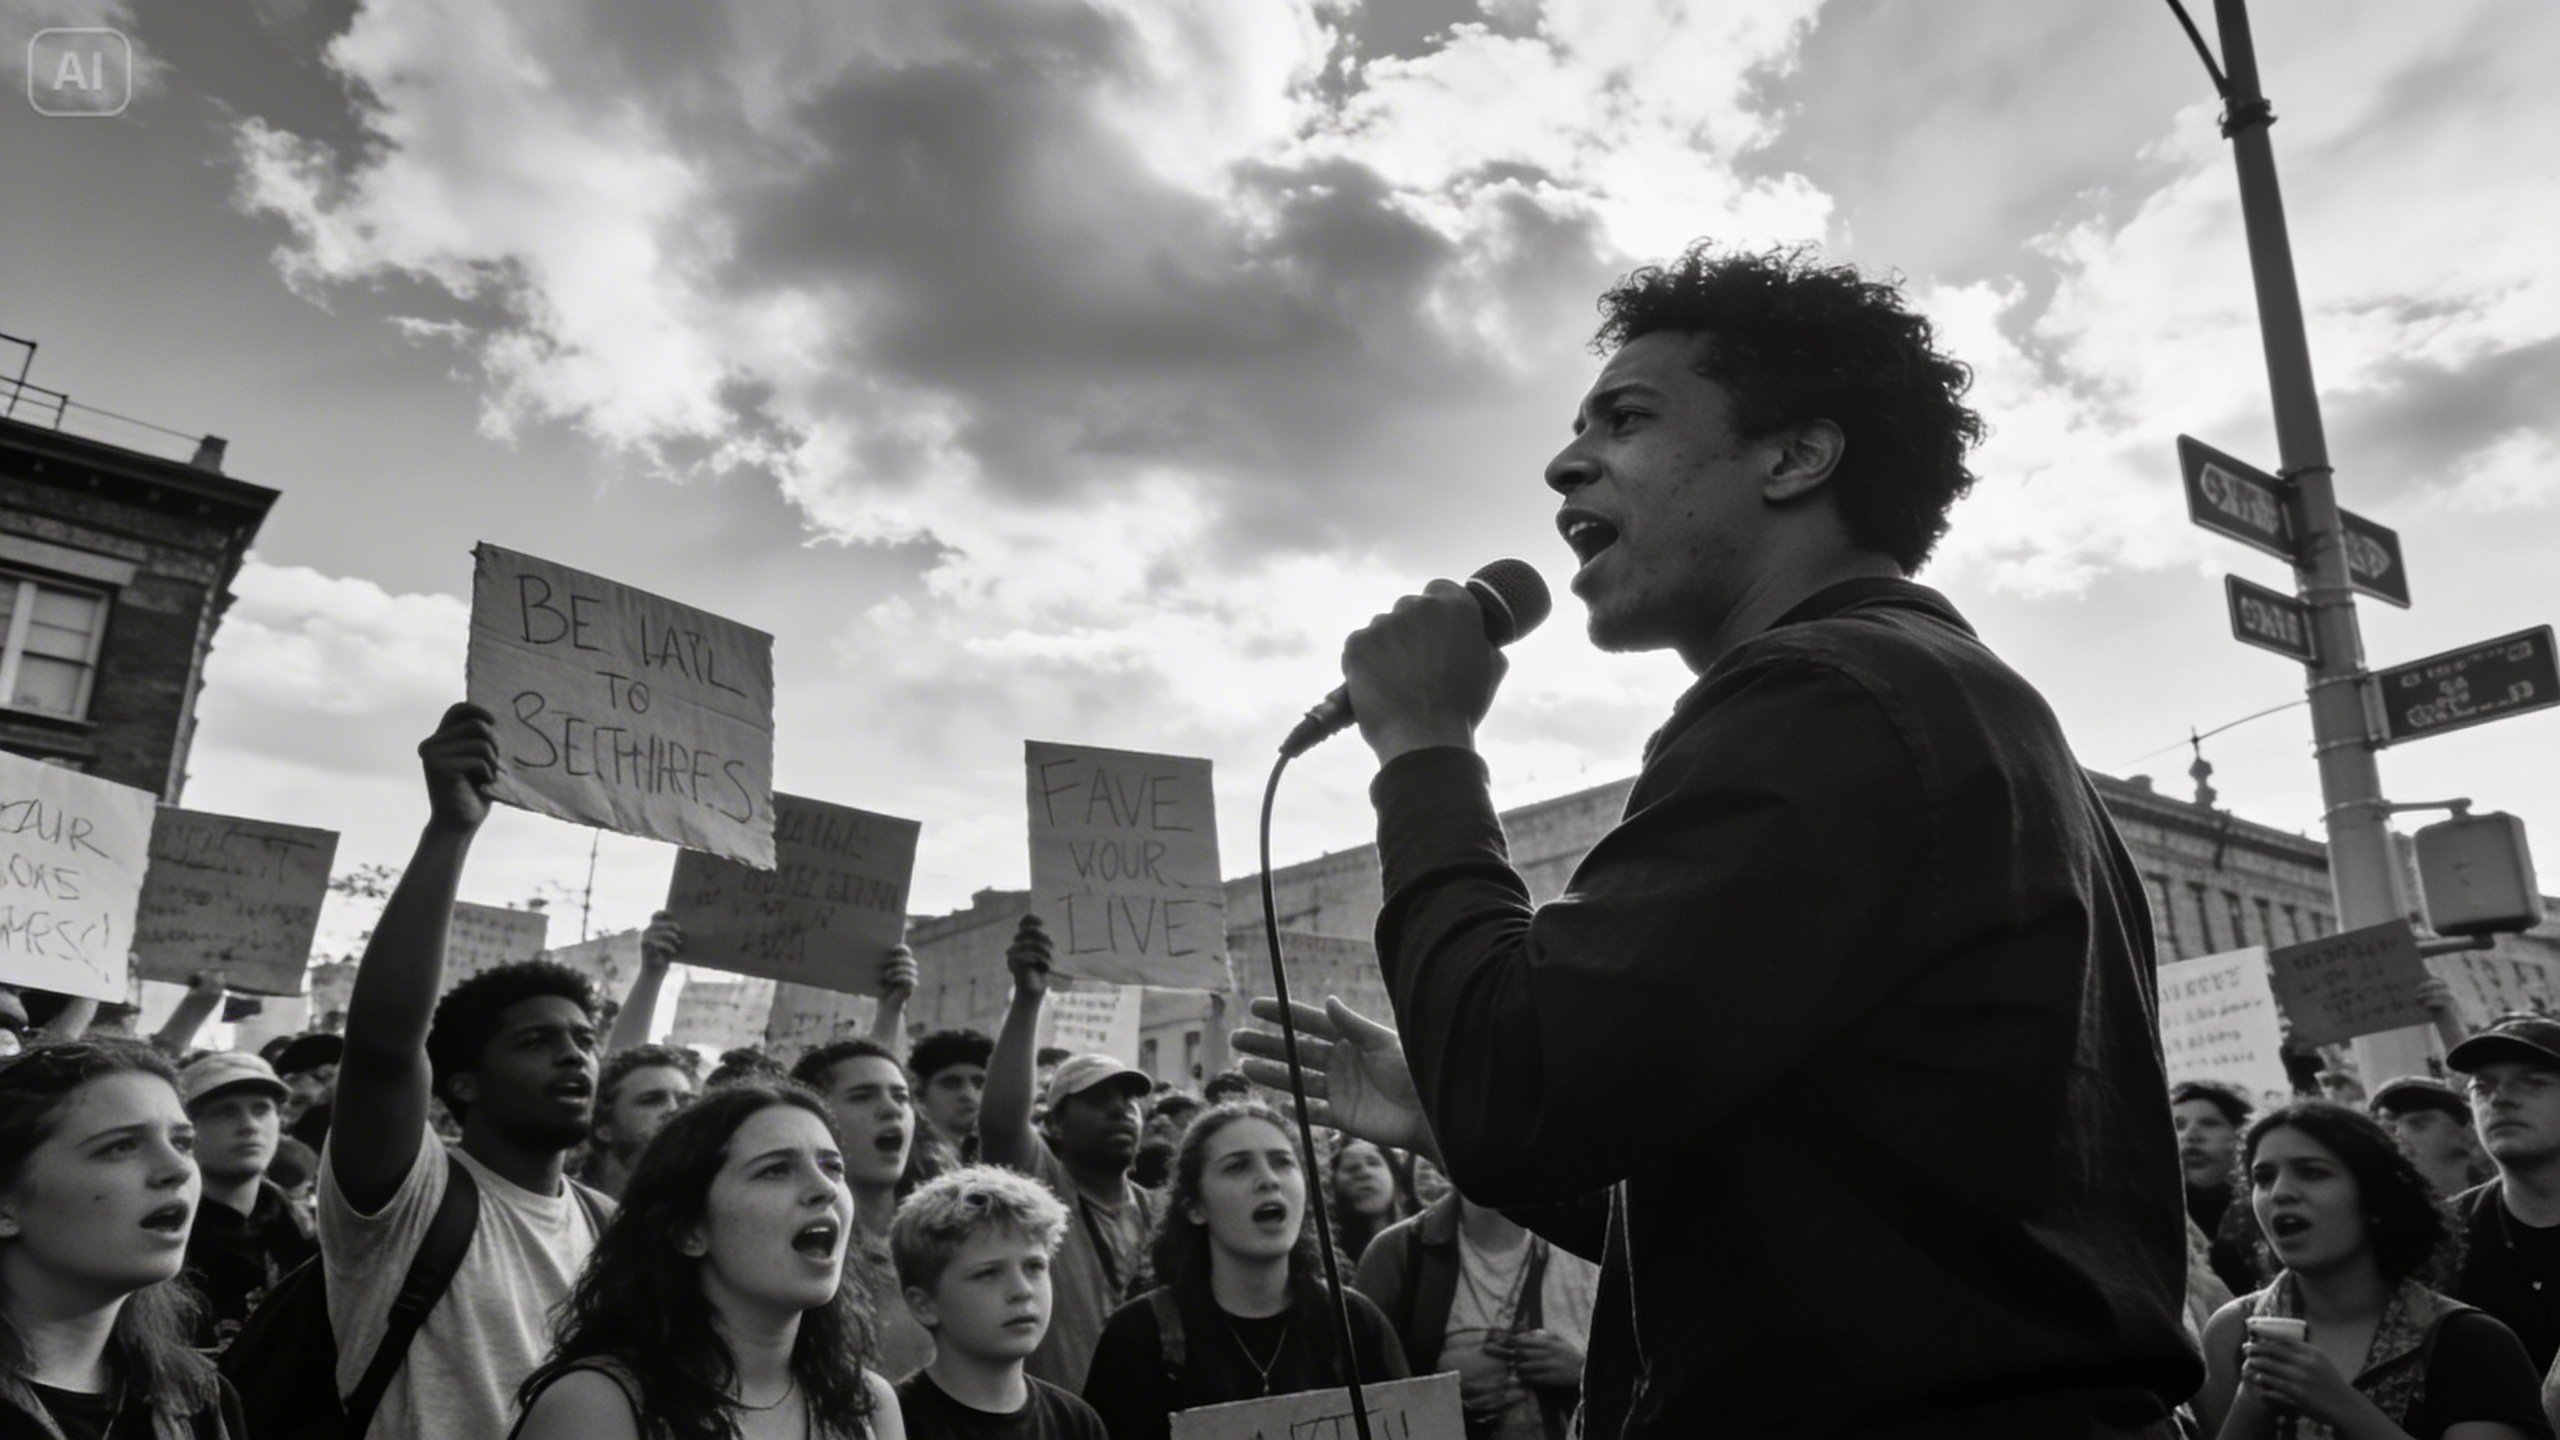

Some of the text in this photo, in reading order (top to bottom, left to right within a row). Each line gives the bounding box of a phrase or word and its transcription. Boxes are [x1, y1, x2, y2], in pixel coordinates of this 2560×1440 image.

[515, 574, 602, 652] BE
[595, 670, 650, 714] TO
[1041, 758, 1194, 832] FAVE
[1057, 893, 1197, 957] LIVE
